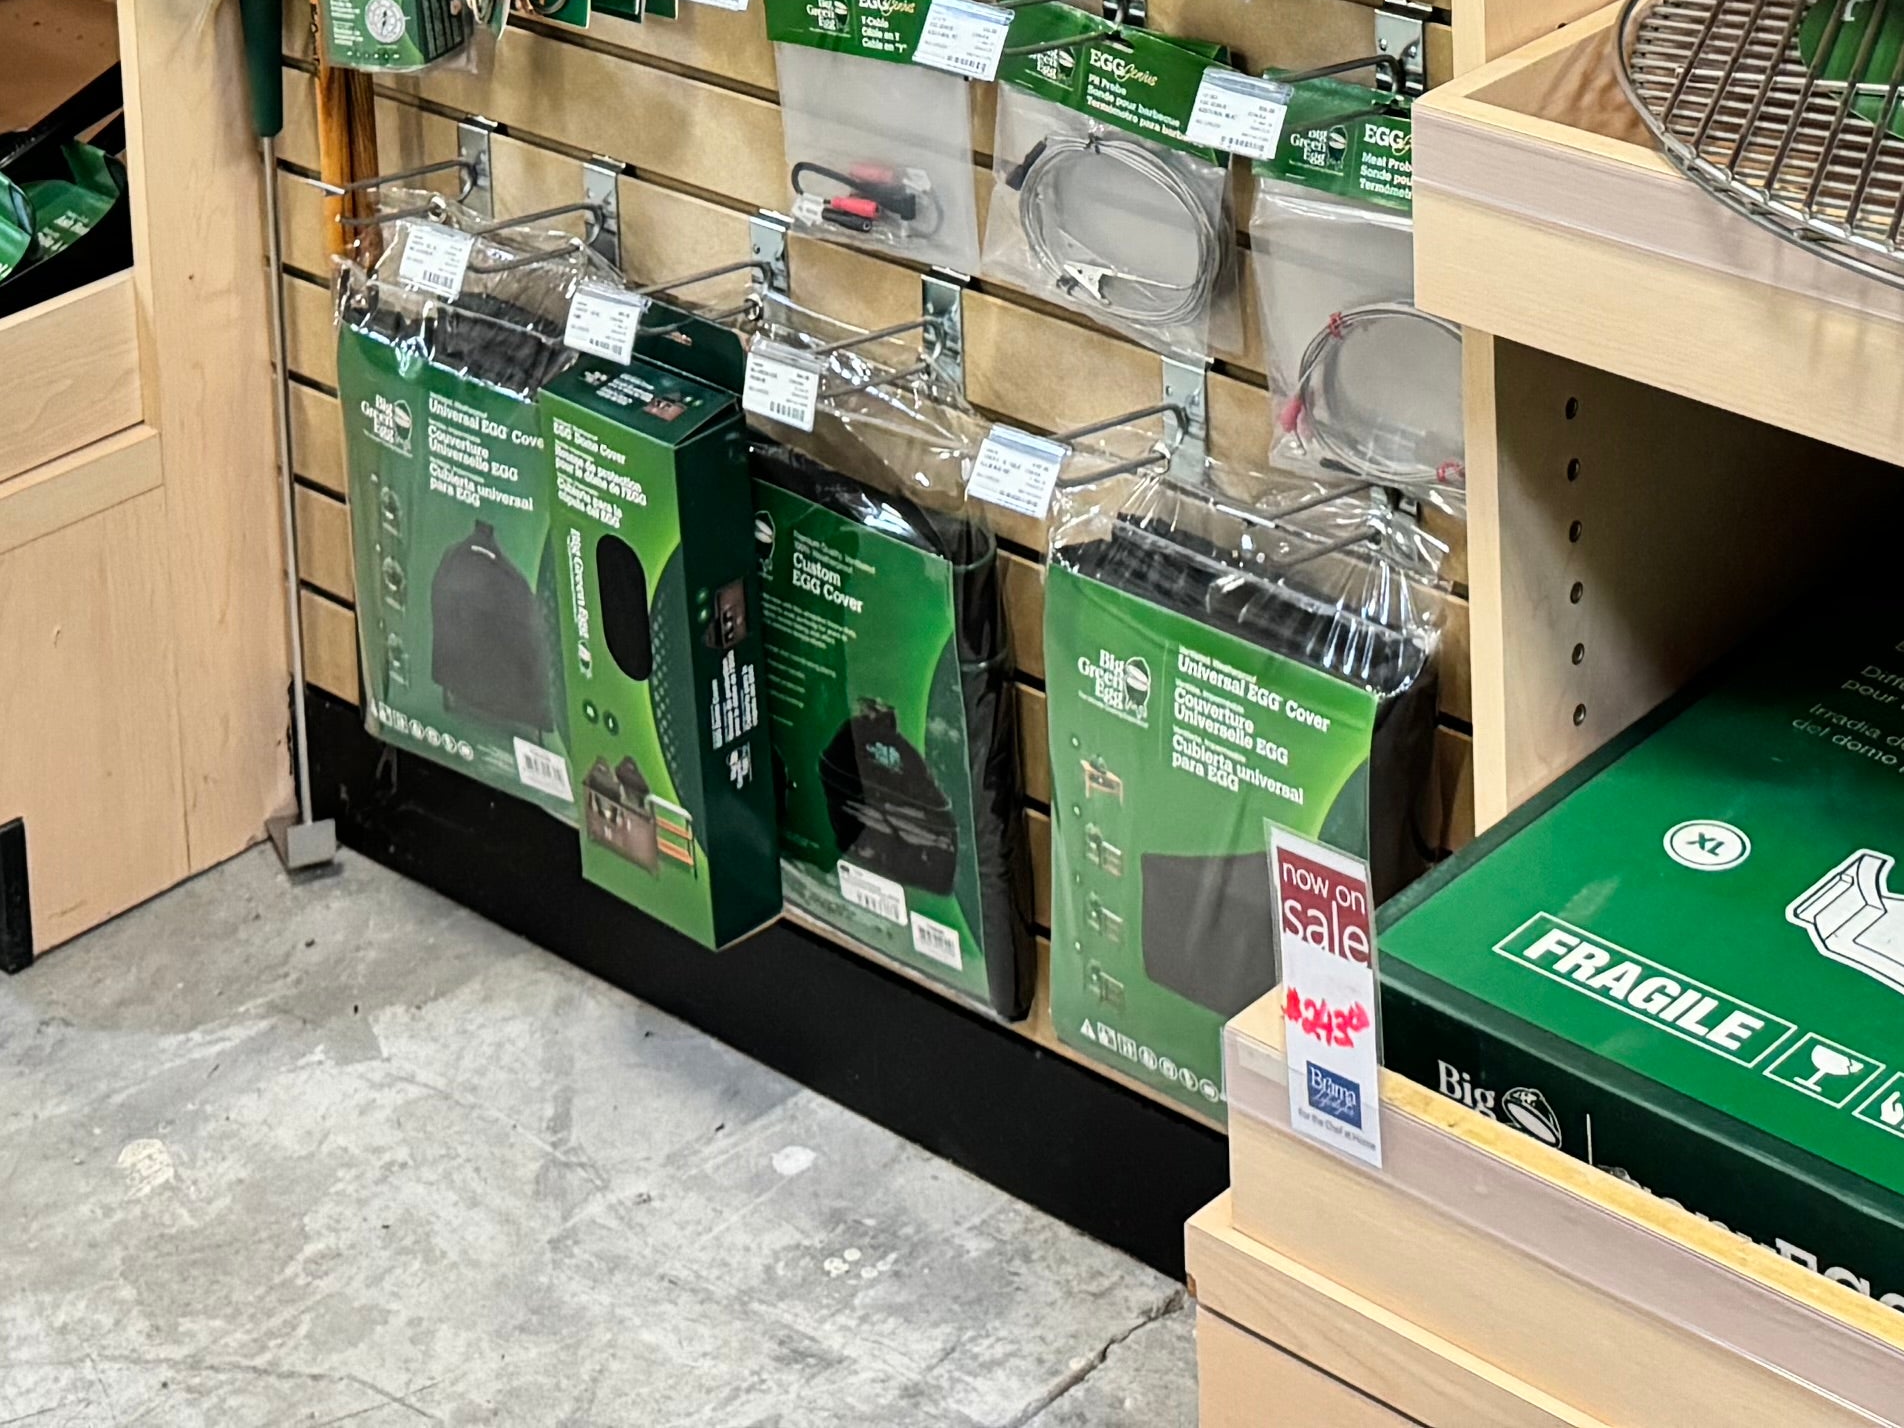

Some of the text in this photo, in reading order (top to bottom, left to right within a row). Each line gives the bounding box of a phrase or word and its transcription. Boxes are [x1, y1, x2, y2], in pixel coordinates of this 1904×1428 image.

[1089, 49, 1126, 76] EGG
[793, 552, 841, 587] Custom
[792, 569, 864, 614] EGG Cover
[1078, 657, 1124, 692] Green
[1099, 649, 1124, 674] Big
[1095, 681, 1124, 710] Egg
[1178, 654, 1246, 698] Universal
[1285, 700, 1331, 734] Cover
[1841, 679, 1898, 705] pour
[1809, 702, 1881, 740] Irradia
[1792, 718, 1828, 738] del
[1831, 733, 1898, 766] domo
[1685, 830, 1729, 860] XL
[1283, 861, 1366, 915] now on
[1283, 900, 1369, 966] sale
[1522, 926, 1760, 1055] FRAGILE
[1310, 1066, 1356, 1105] Brama
[1437, 1059, 1497, 1121] Big
